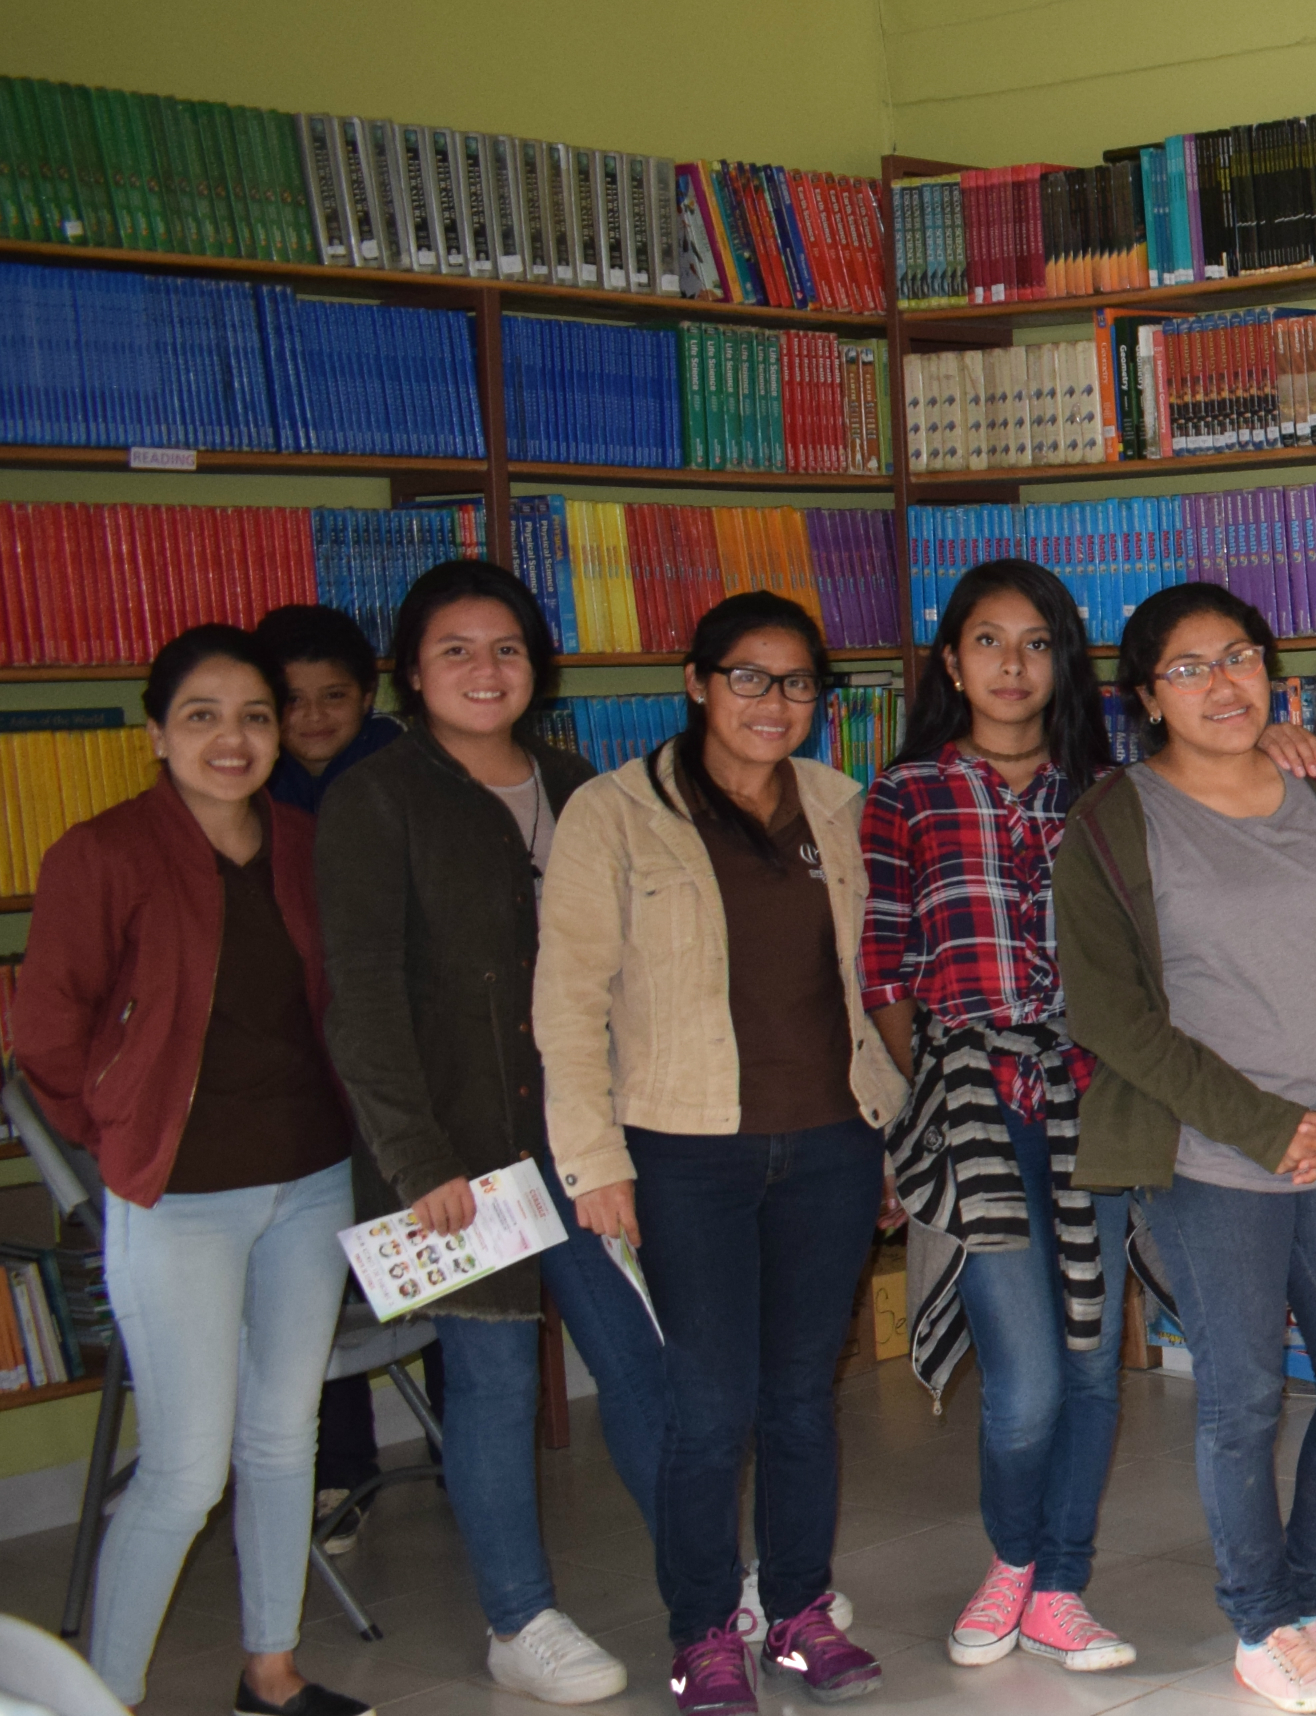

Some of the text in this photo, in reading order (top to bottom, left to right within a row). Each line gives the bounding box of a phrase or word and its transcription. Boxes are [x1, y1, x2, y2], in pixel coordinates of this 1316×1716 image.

[691, 357, 699, 390] Science
[708, 358, 716, 391] Science
[1120, 345, 1128, 391] Geometry
[132, 450, 195, 467] READING
[1064, 536, 1072, 563] Math
[1109, 533, 1118, 561] Math
[1175, 530, 1183, 558] Math
[1291, 519, 1300, 550] Math
[541, 520, 554, 592] Physical Science
